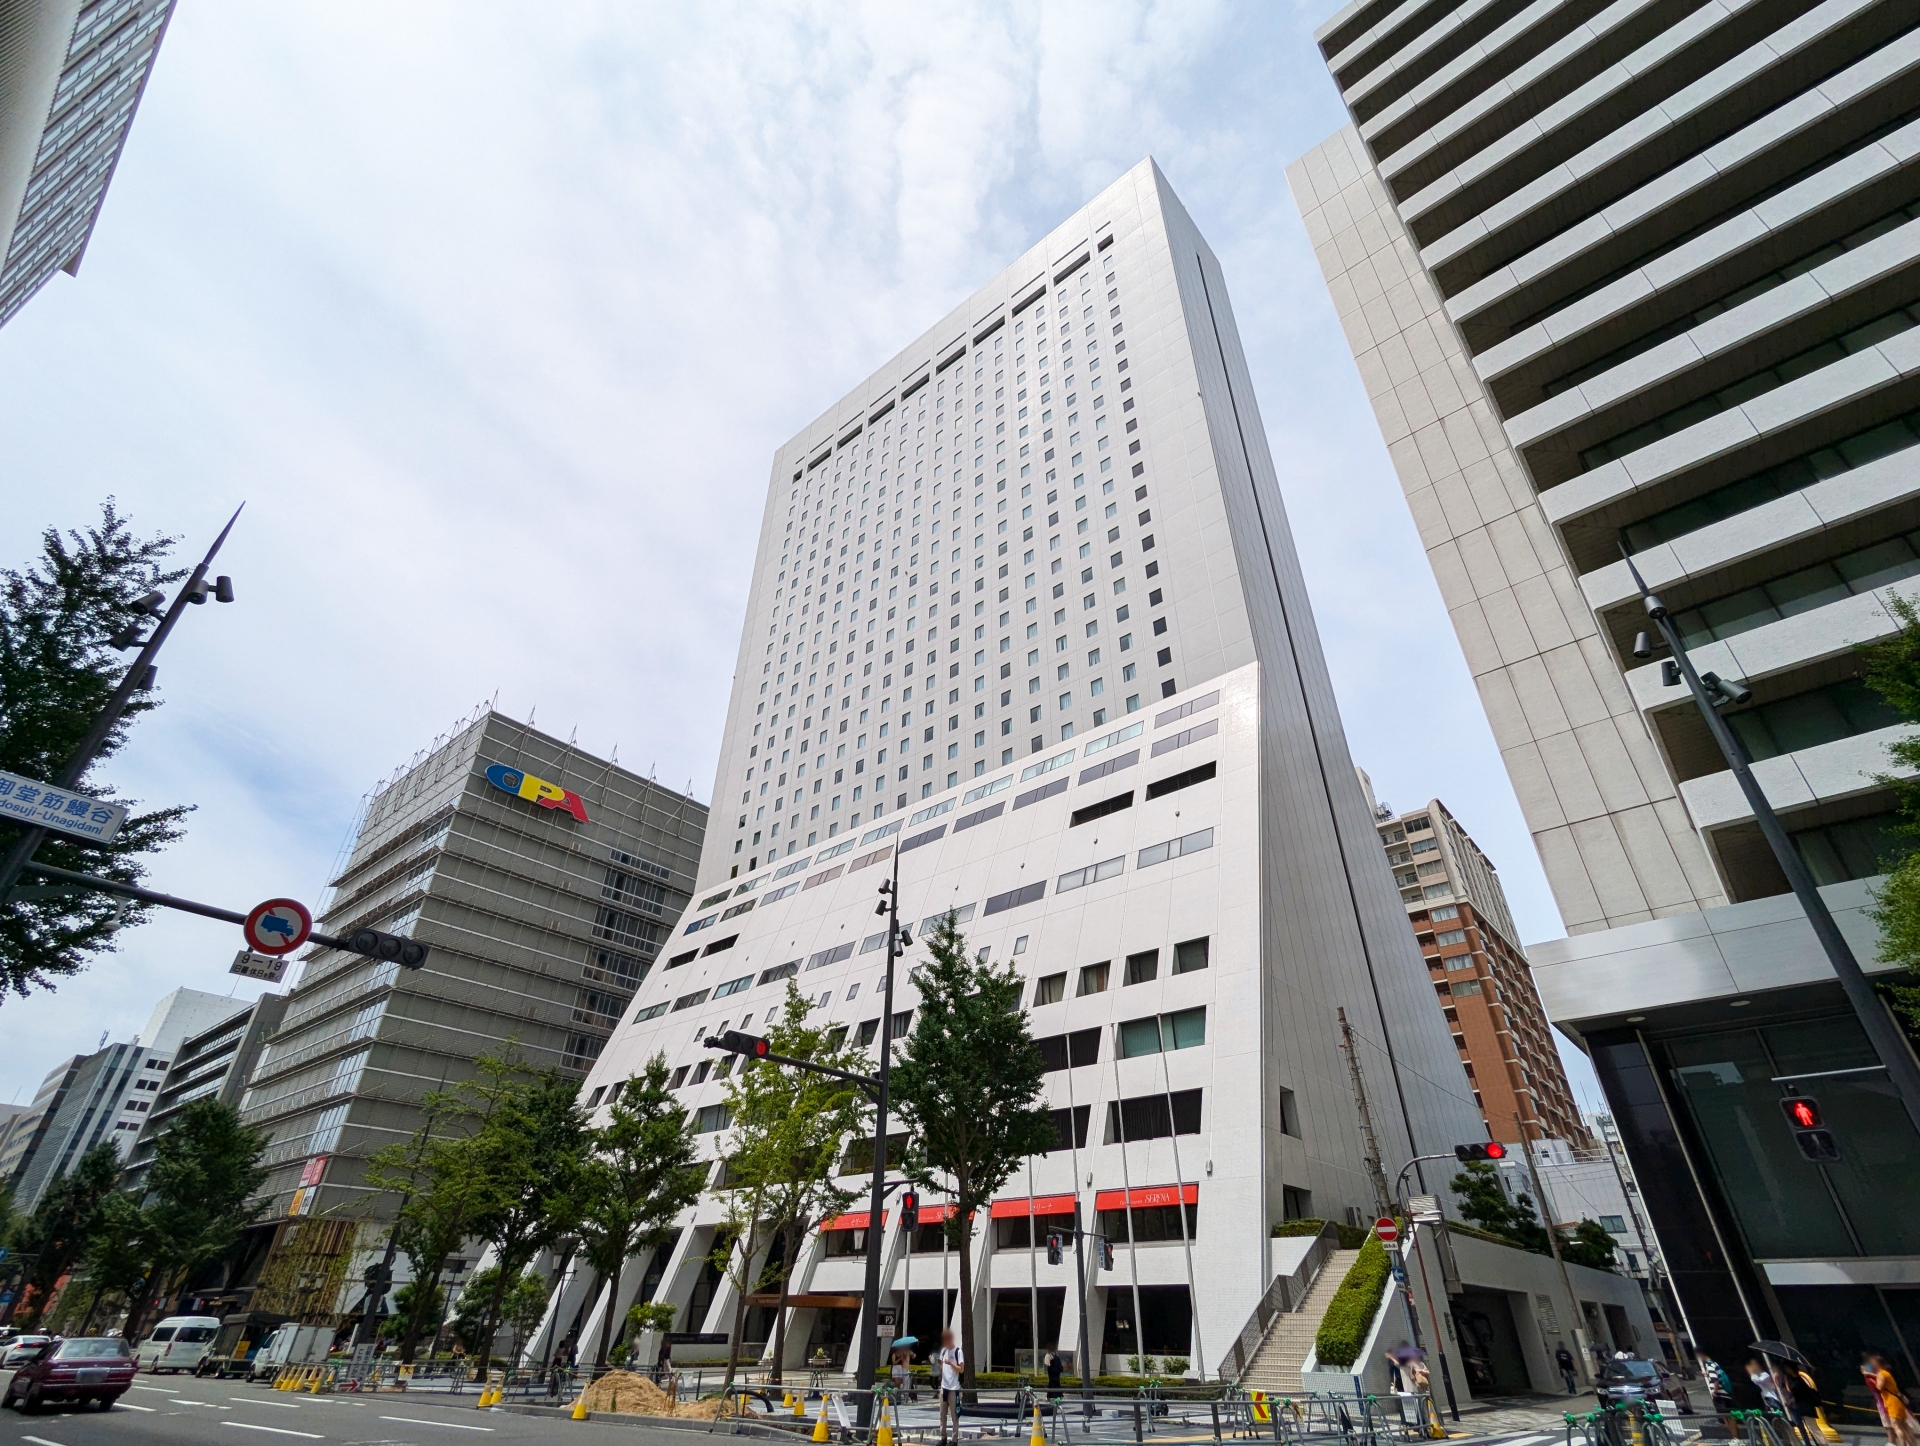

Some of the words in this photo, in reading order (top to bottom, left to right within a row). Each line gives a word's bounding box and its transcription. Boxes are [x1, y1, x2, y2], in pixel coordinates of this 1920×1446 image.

[485, 763, 590, 823] OPA
[1144, 1193, 1170, 1204] SERENA
[1033, 1203, 1053, 1213] リーナ
